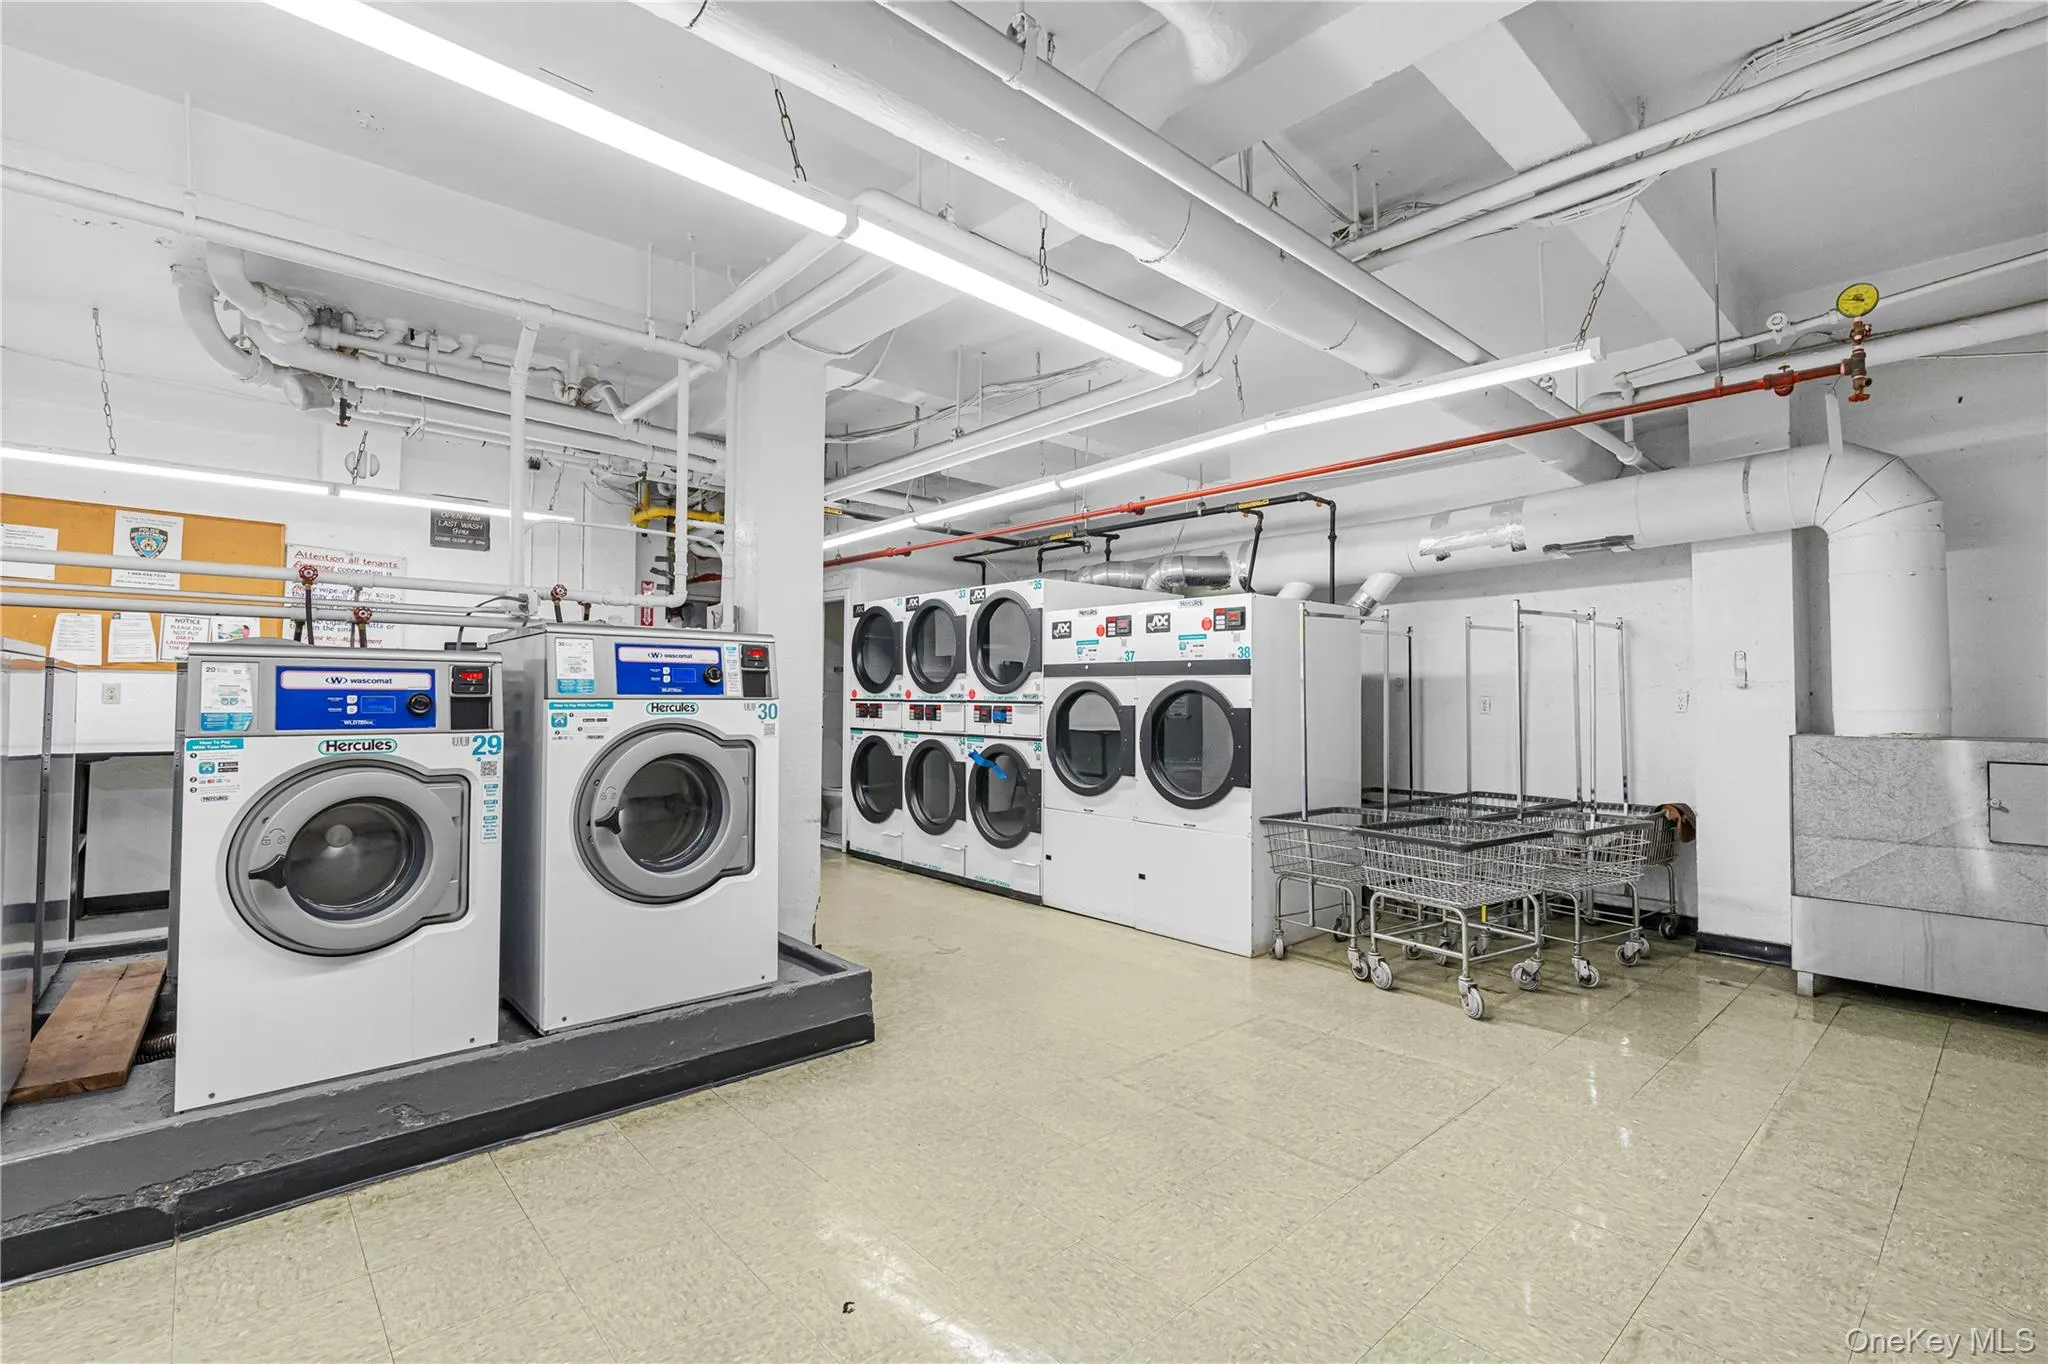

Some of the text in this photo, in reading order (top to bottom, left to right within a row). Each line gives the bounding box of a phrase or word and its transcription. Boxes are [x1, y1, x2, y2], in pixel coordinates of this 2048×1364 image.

[441, 511, 463, 520] OPEN
[438, 519, 484, 530] LAST WASH
[452, 528, 469, 536] 9PM
[294, 550, 344, 563] Attention
[348, 556, 359, 564] all
[1032, 579, 1042, 590] 35
[958, 589, 966, 599] 33
[1124, 651, 1135, 662] 37
[1237, 646, 1251, 658] 38
[650, 702, 696, 712] Hercules
[758, 703, 778, 720] 30
[325, 739, 392, 752] Hercules
[472, 734, 502, 756] 29
[958, 737, 966, 746] 34
[1033, 742, 1042, 752] 36
